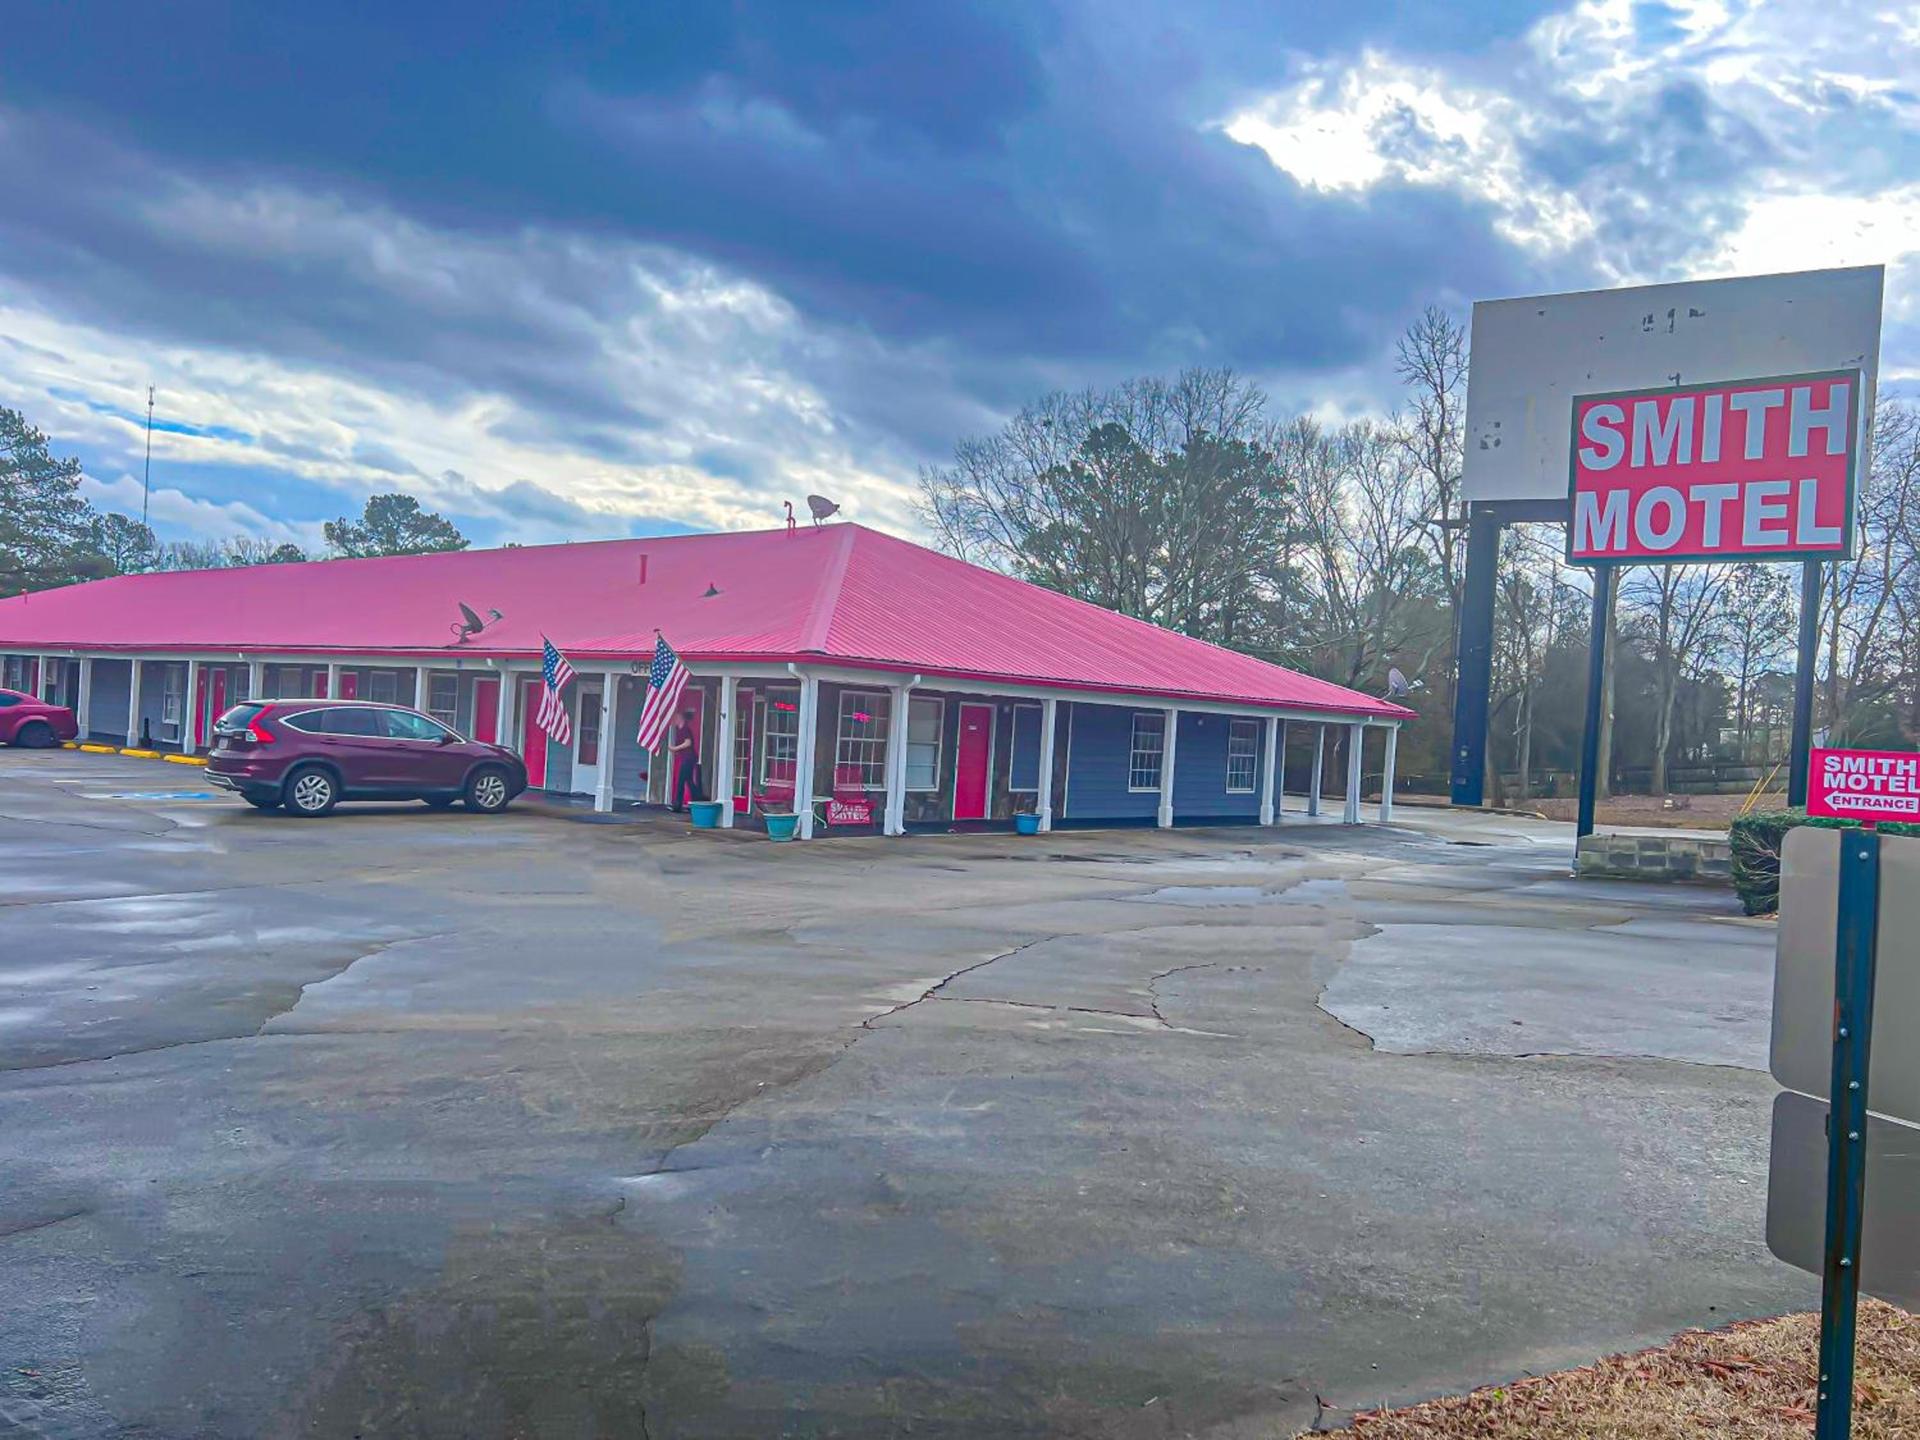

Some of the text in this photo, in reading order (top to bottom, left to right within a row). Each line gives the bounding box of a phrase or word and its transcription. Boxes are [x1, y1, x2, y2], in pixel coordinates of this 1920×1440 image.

[1578, 383, 1850, 471] SMITH
[1573, 478, 1842, 552] MOTEL
[1824, 755, 1917, 776] SMITH
[1823, 772, 1920, 793] MOTEL
[1832, 795, 1915, 810] ENTRANCE
